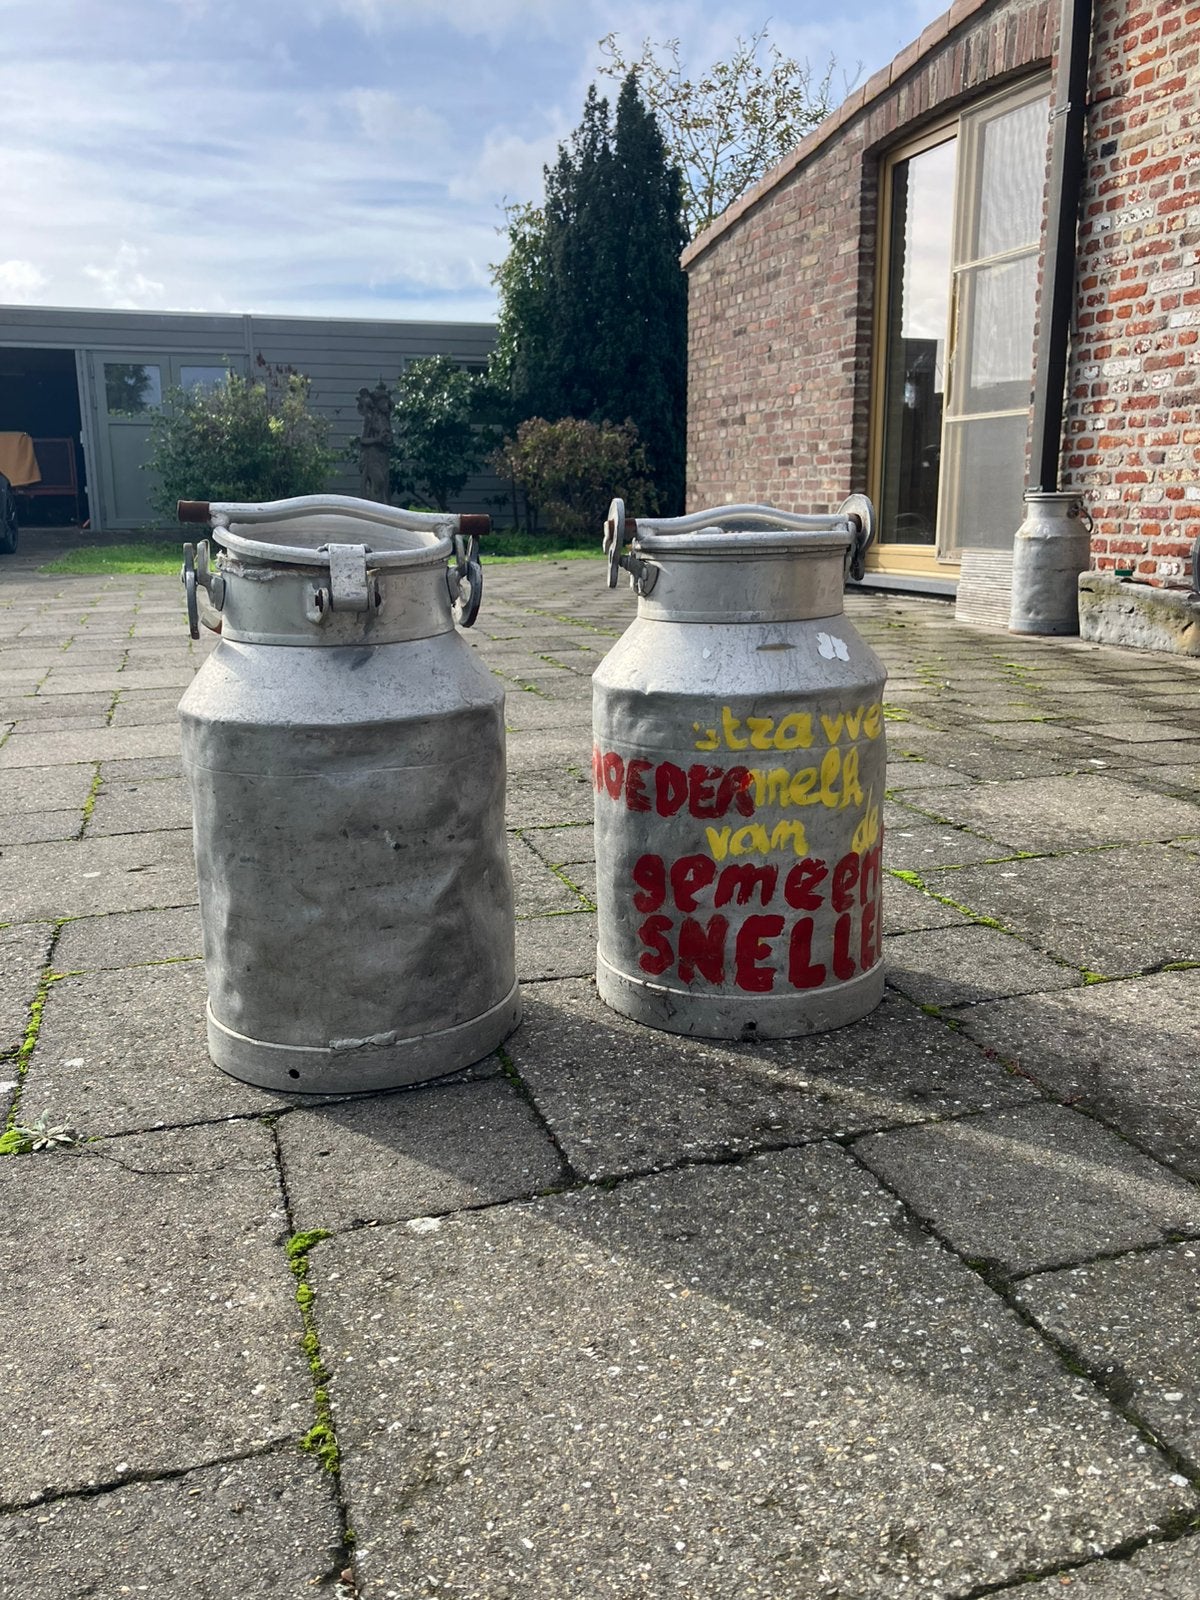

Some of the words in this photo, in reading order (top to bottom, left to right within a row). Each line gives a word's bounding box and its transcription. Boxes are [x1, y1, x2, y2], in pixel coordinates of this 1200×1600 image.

[705, 819, 810, 861] van
[633, 846, 884, 913] gemeen
[637, 900, 883, 992] SNELLE
